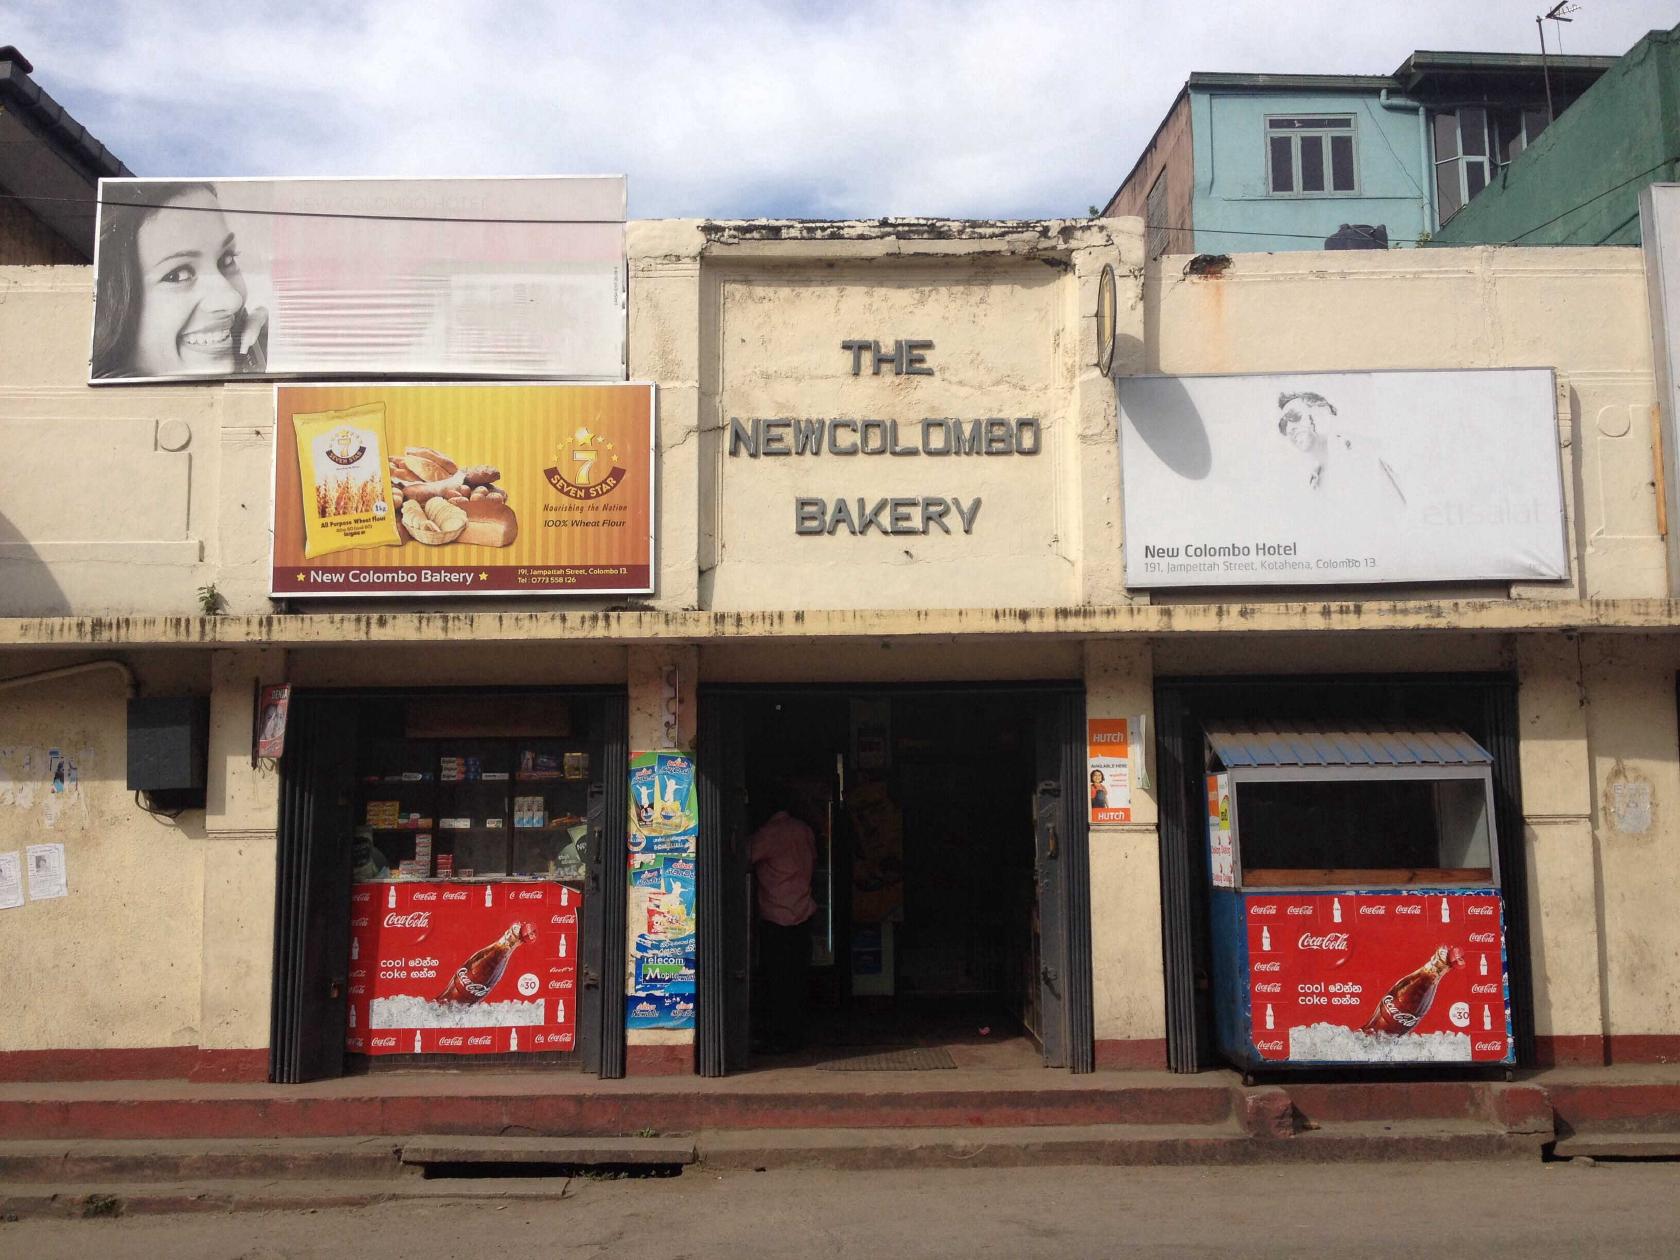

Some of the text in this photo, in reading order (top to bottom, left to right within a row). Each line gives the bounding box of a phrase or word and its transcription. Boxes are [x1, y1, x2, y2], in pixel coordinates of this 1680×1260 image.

[842, 339, 935, 376] THE
[573, 450, 598, 485] 7
[551, 475, 617, 498] SEVEN STAR
[543, 503, 628, 513] Nourishing the Nation
[795, 497, 982, 535] BAKERY
[330, 520, 352, 528] Purpose
[544, 519, 626, 528] 100% Wheat Flour
[1145, 542, 1297, 559] New Colombo Hotel
[588, 567, 619, 575] Colombo
[1167, 561, 1220, 573] Jampettah
[1223, 560, 1257, 572] Street,
[1260, 559, 1313, 571] Kotahena,
[1316, 558, 1361, 569] Colombo
[1363, 558, 1377, 568] 13
[310, 570, 475, 586] New Colombo Bakery
[413, 892, 437, 901] Coca-Cola
[443, 891, 468, 900] Coca-Cola
[519, 890, 544, 899] Coca-Cola
[1251, 905, 1494, 915] Coca-Cola Coca-Cola Coca-Cola Coca-Cola Coca-Cola
[384, 911, 432, 928] Coca-Cola
[552, 914, 576, 924] Coca-Cola
[1298, 932, 1350, 950] Coca-Cola
[1469, 932, 1495, 943] Coca-Cola
[381, 958, 405, 968] cool
[1254, 962, 1281, 972] Coca-Cola
[380, 969, 407, 979] coke
[458, 967, 490, 997] Coca-Cola
[524, 981, 537, 990] 30
[549, 980, 573, 989] Coca-Cola
[1255, 982, 1282, 993] Coca-Cola
[1298, 982, 1325, 993] cool
[1471, 983, 1498, 994] Coca-Cola
[1298, 994, 1328, 1005] coke
[1384, 994, 1418, 1027] Coca-Cola
[1456, 1011, 1469, 1020] 30
[372, 1037, 397, 1047] Coca-Cola
[439, 1036, 464, 1046] Coca-Cola
[467, 1035, 492, 1045] Coca-Cola
[547, 1033, 572, 1043] Coca-Cola
[1257, 1040, 1284, 1051] Coca-Cola
[1475, 1040, 1502, 1051] Coca-Cola
